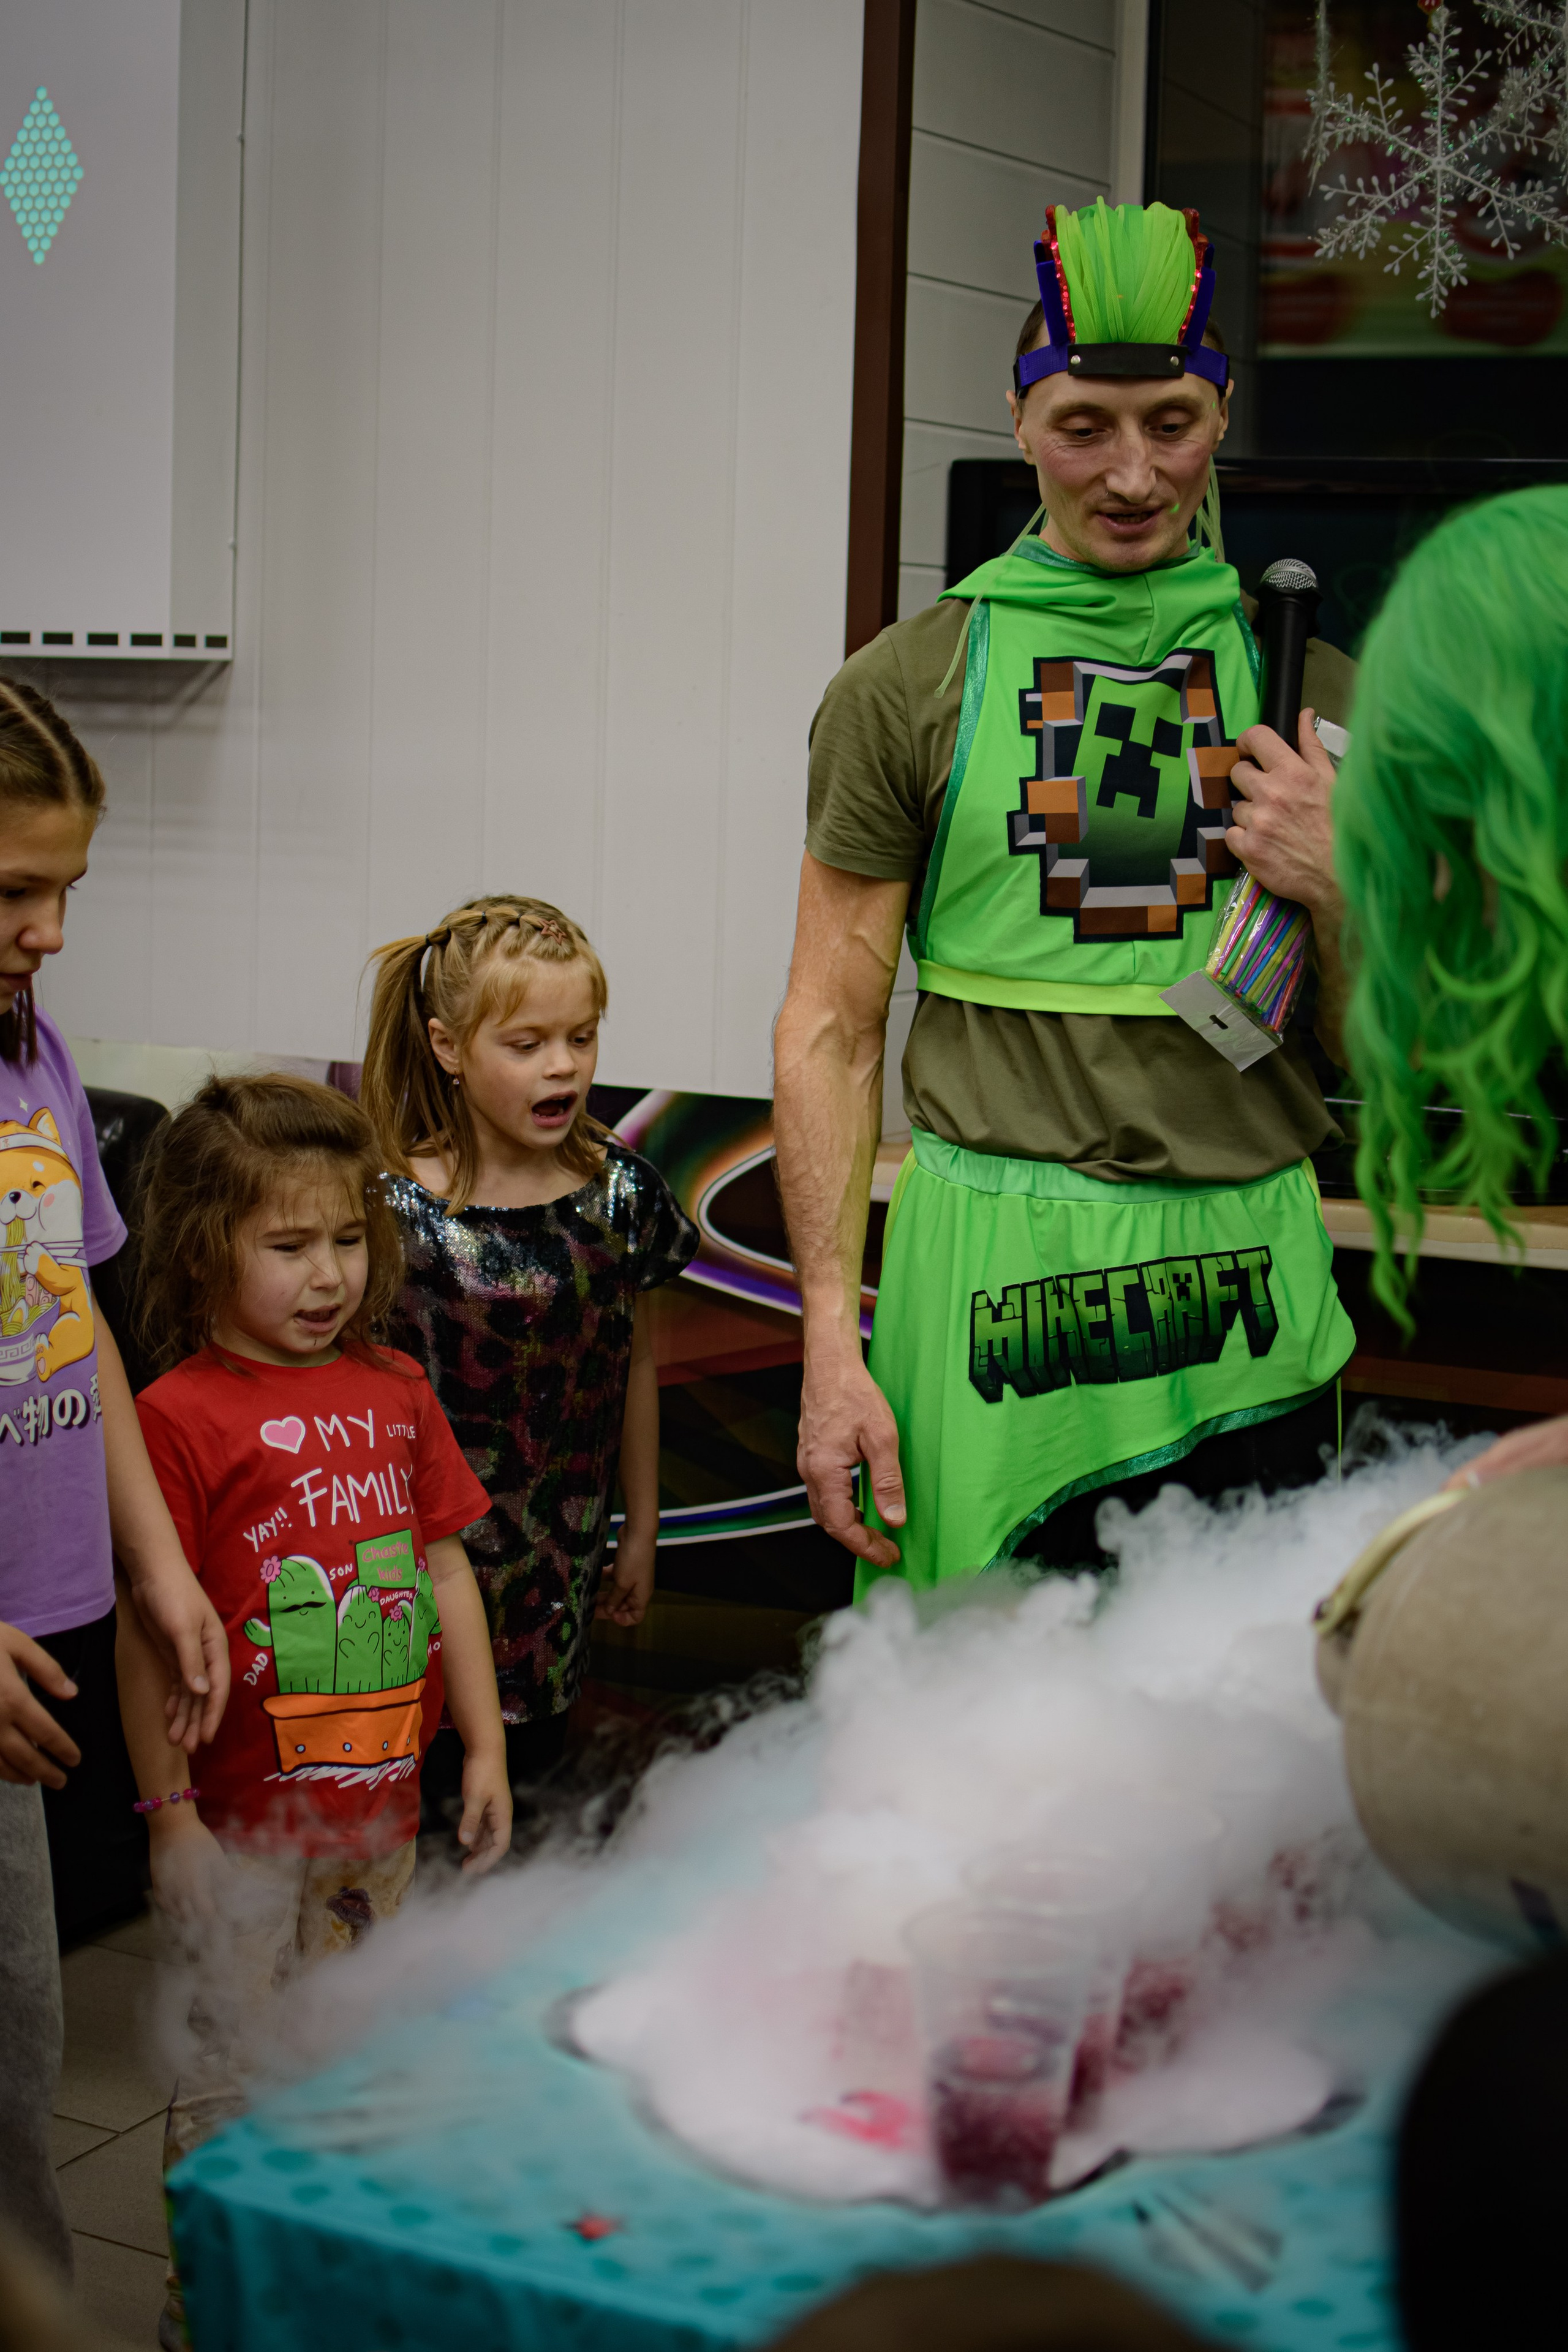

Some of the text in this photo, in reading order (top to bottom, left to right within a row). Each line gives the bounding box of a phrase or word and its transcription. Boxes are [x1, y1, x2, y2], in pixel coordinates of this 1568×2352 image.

[969, 1245, 1279, 1403] MINECRAFT
[314, 1409, 416, 1451] MY LITTLE
[290, 1463, 414, 1528] FAMILY
[243, 1507, 292, 1553] YAY!!
[363, 1541, 409, 1562] Chaste
[330, 1563, 353, 1581] SON
[377, 1564, 402, 1581] kids
[380, 1591, 413, 1606] DAUGHTER
[243, 1653, 268, 1686] DAD
